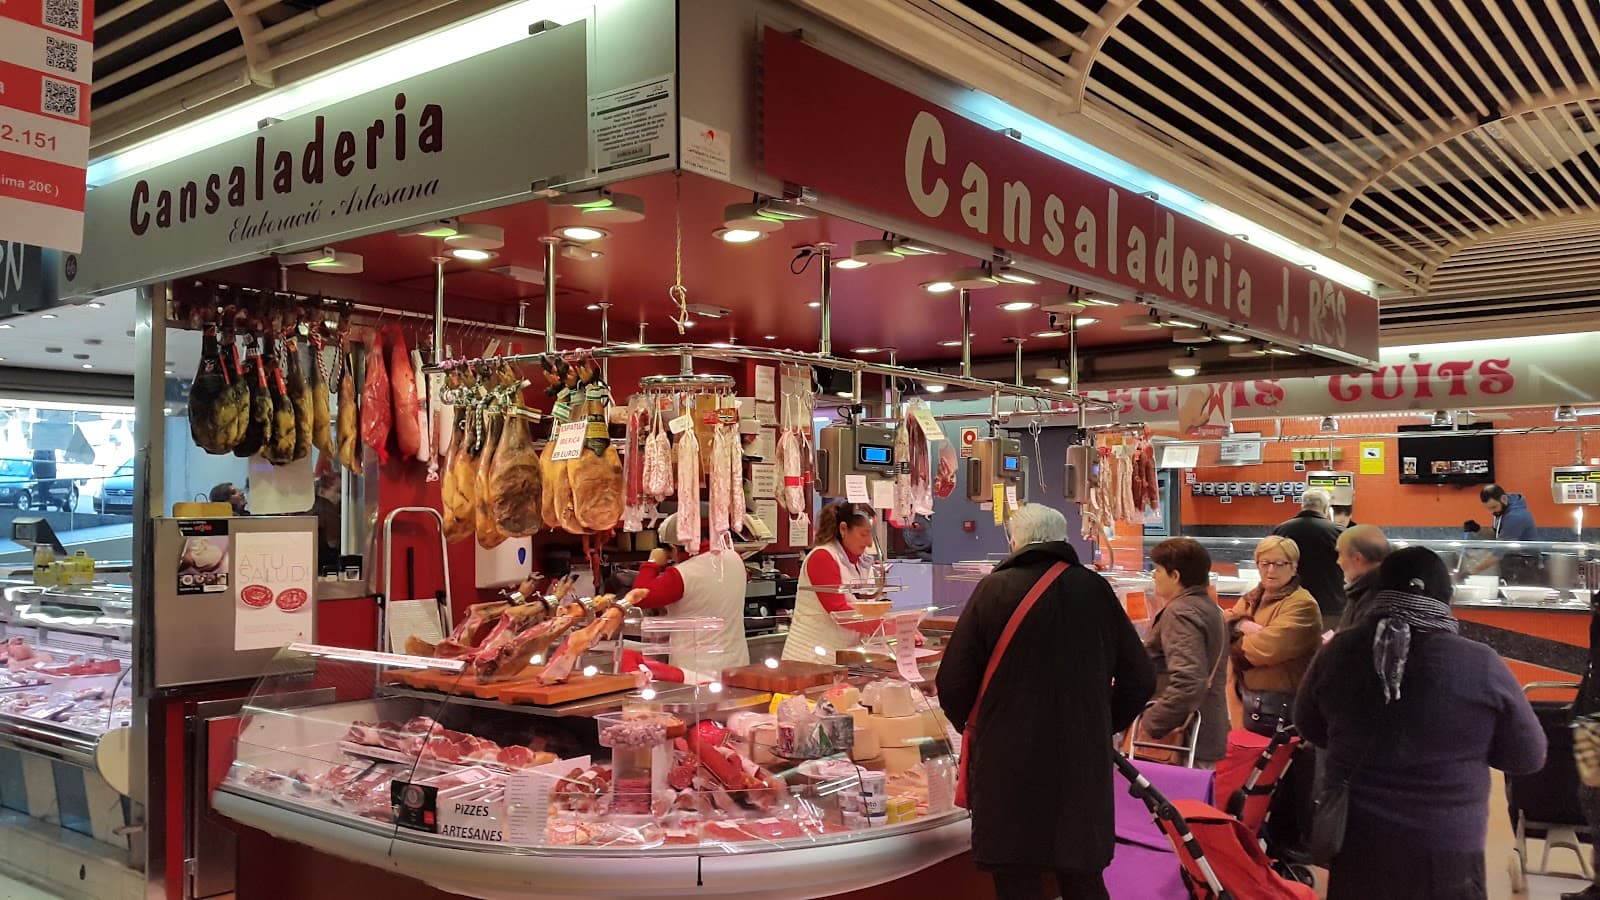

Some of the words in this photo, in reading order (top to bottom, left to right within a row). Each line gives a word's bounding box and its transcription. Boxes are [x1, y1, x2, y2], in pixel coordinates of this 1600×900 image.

[28, 180, 52, 194] 20€
[130, 92, 443, 236] Cansaladeria
[229, 200, 323, 243] Elaboració
[331, 178, 440, 217] Artesana
[904, 110, 1252, 318] Cansaladeria
[1277, 266, 1299, 335] J.
[1327, 357, 1515, 403] CUITS
[442, 824, 503, 841] ARTESANES
[454, 803, 489, 817] PIZZES
